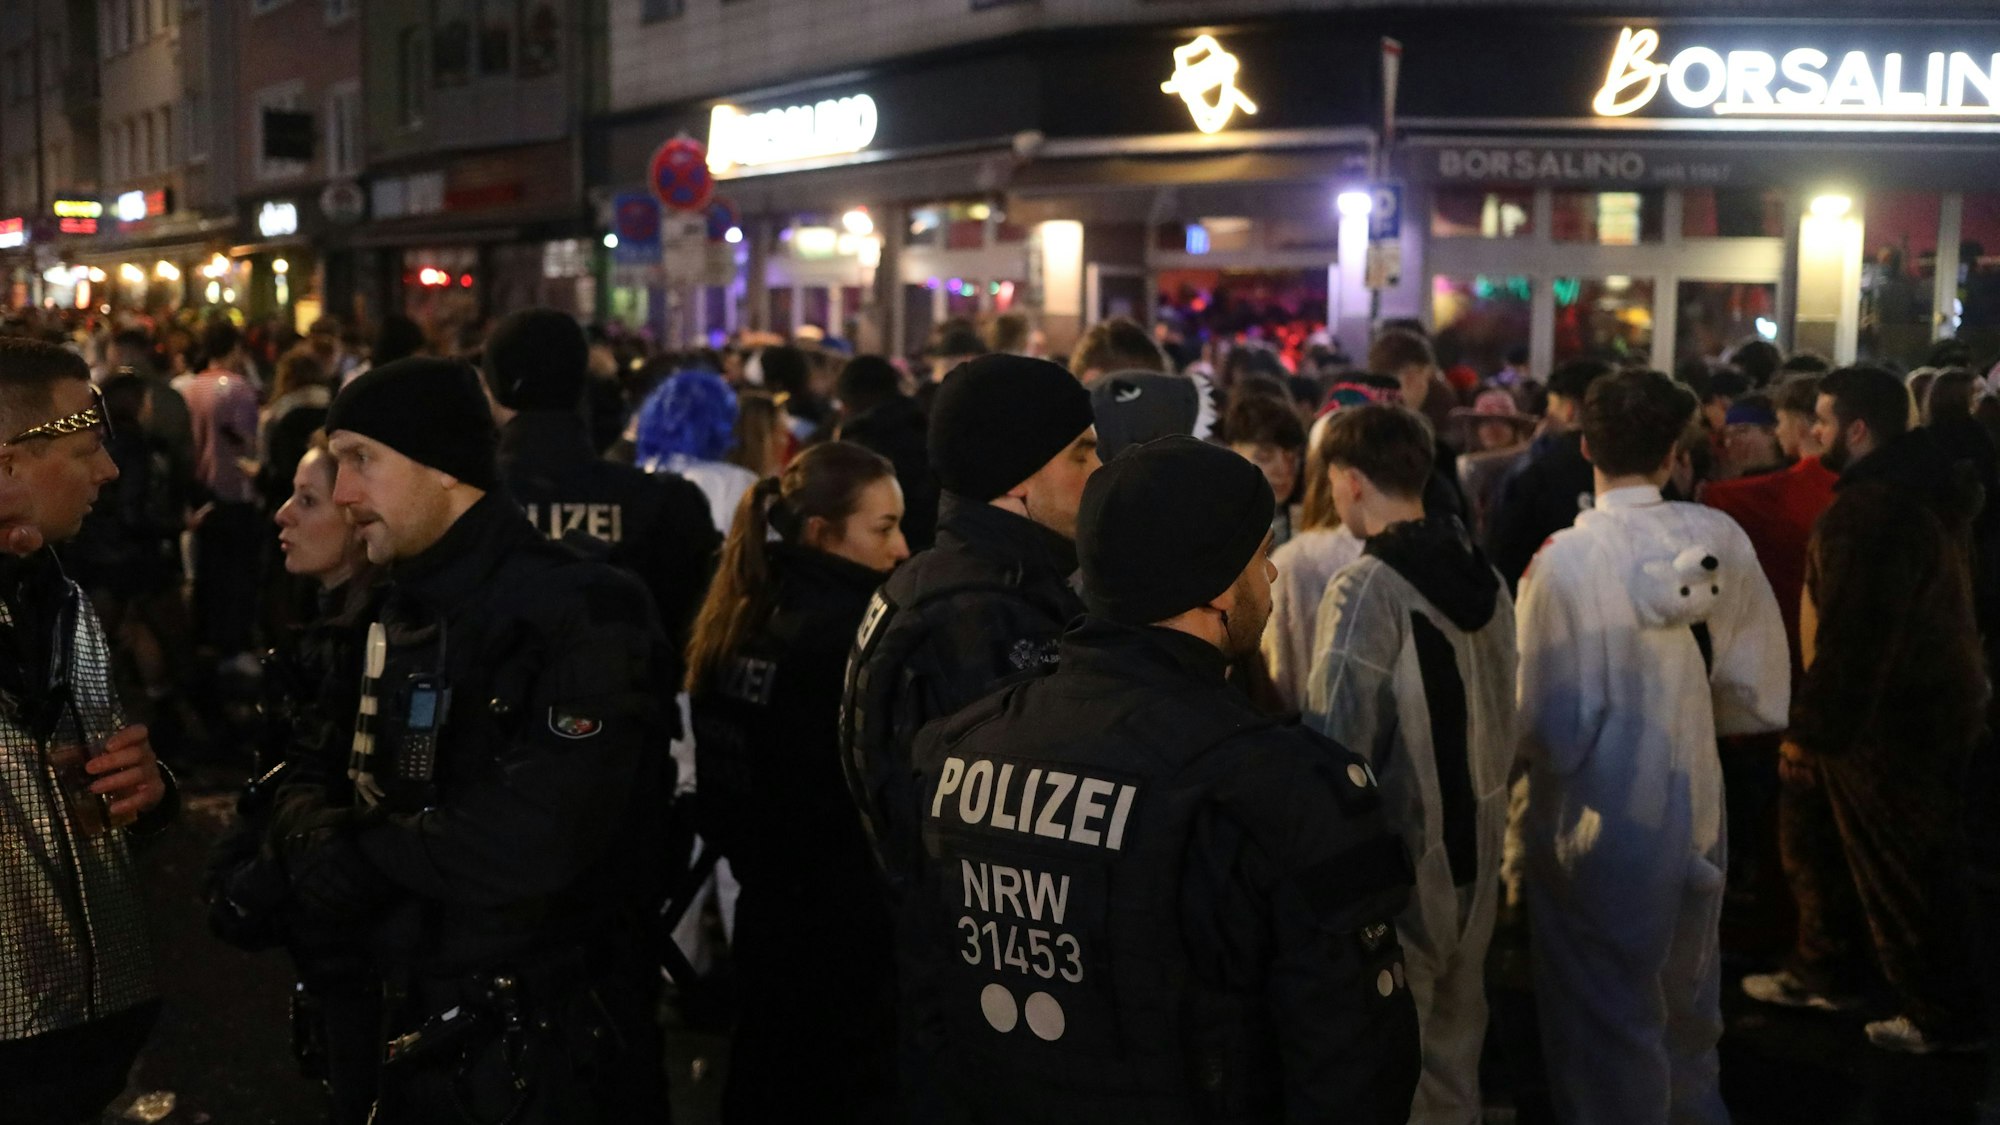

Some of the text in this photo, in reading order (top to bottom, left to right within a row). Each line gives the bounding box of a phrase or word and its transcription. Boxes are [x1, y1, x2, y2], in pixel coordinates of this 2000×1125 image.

[1438, 150, 1646, 180] BORSALINO
[931, 757, 1136, 850] POLIZEI
[961, 859, 1070, 925] NRW
[957, 915, 1084, 983] 31453
